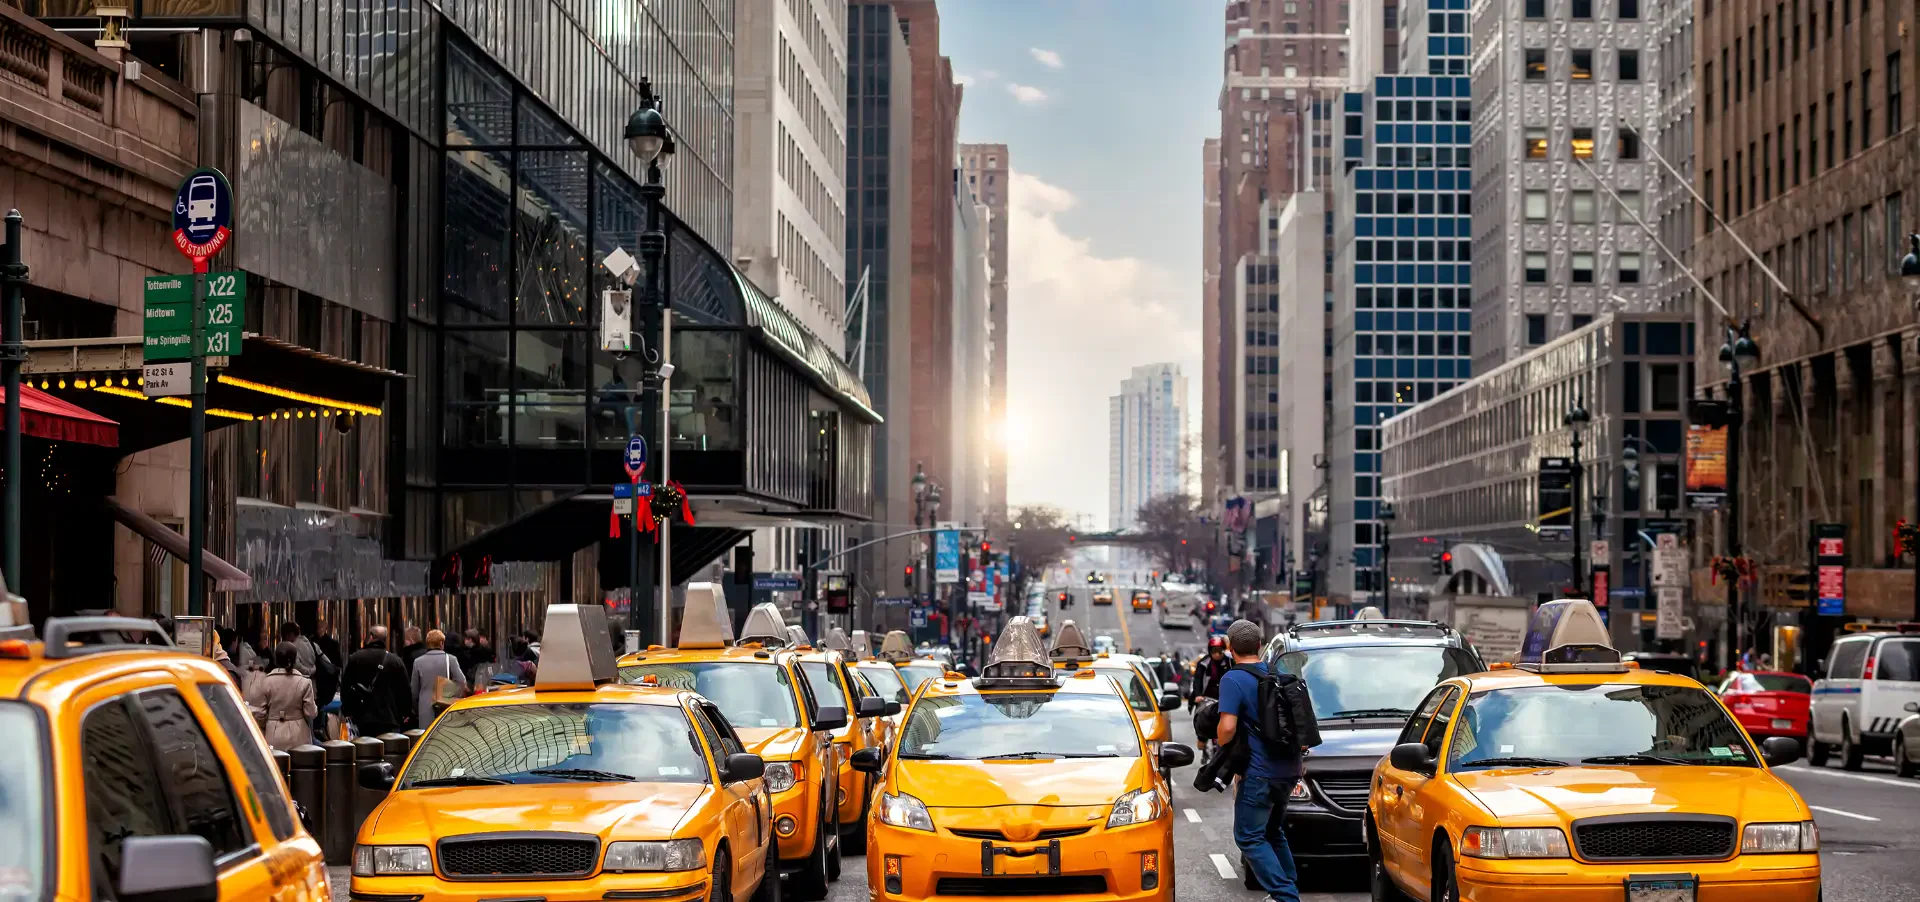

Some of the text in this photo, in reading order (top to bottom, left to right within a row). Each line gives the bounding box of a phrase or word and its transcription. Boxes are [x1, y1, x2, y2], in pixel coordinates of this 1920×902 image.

[176, 231, 225, 256] NO STANDING
[147, 279, 182, 290] Tottenville
[208, 275, 236, 297] x22
[146, 308, 175, 318] Midtown
[208, 303, 233, 325] x25
[146, 334, 191, 347] New Springville
[206, 331, 230, 353] x31
[151, 368, 160, 376] 42
[160, 368, 168, 376] St
[169, 367, 174, 376] &
[146, 380, 169, 389] Park Av
